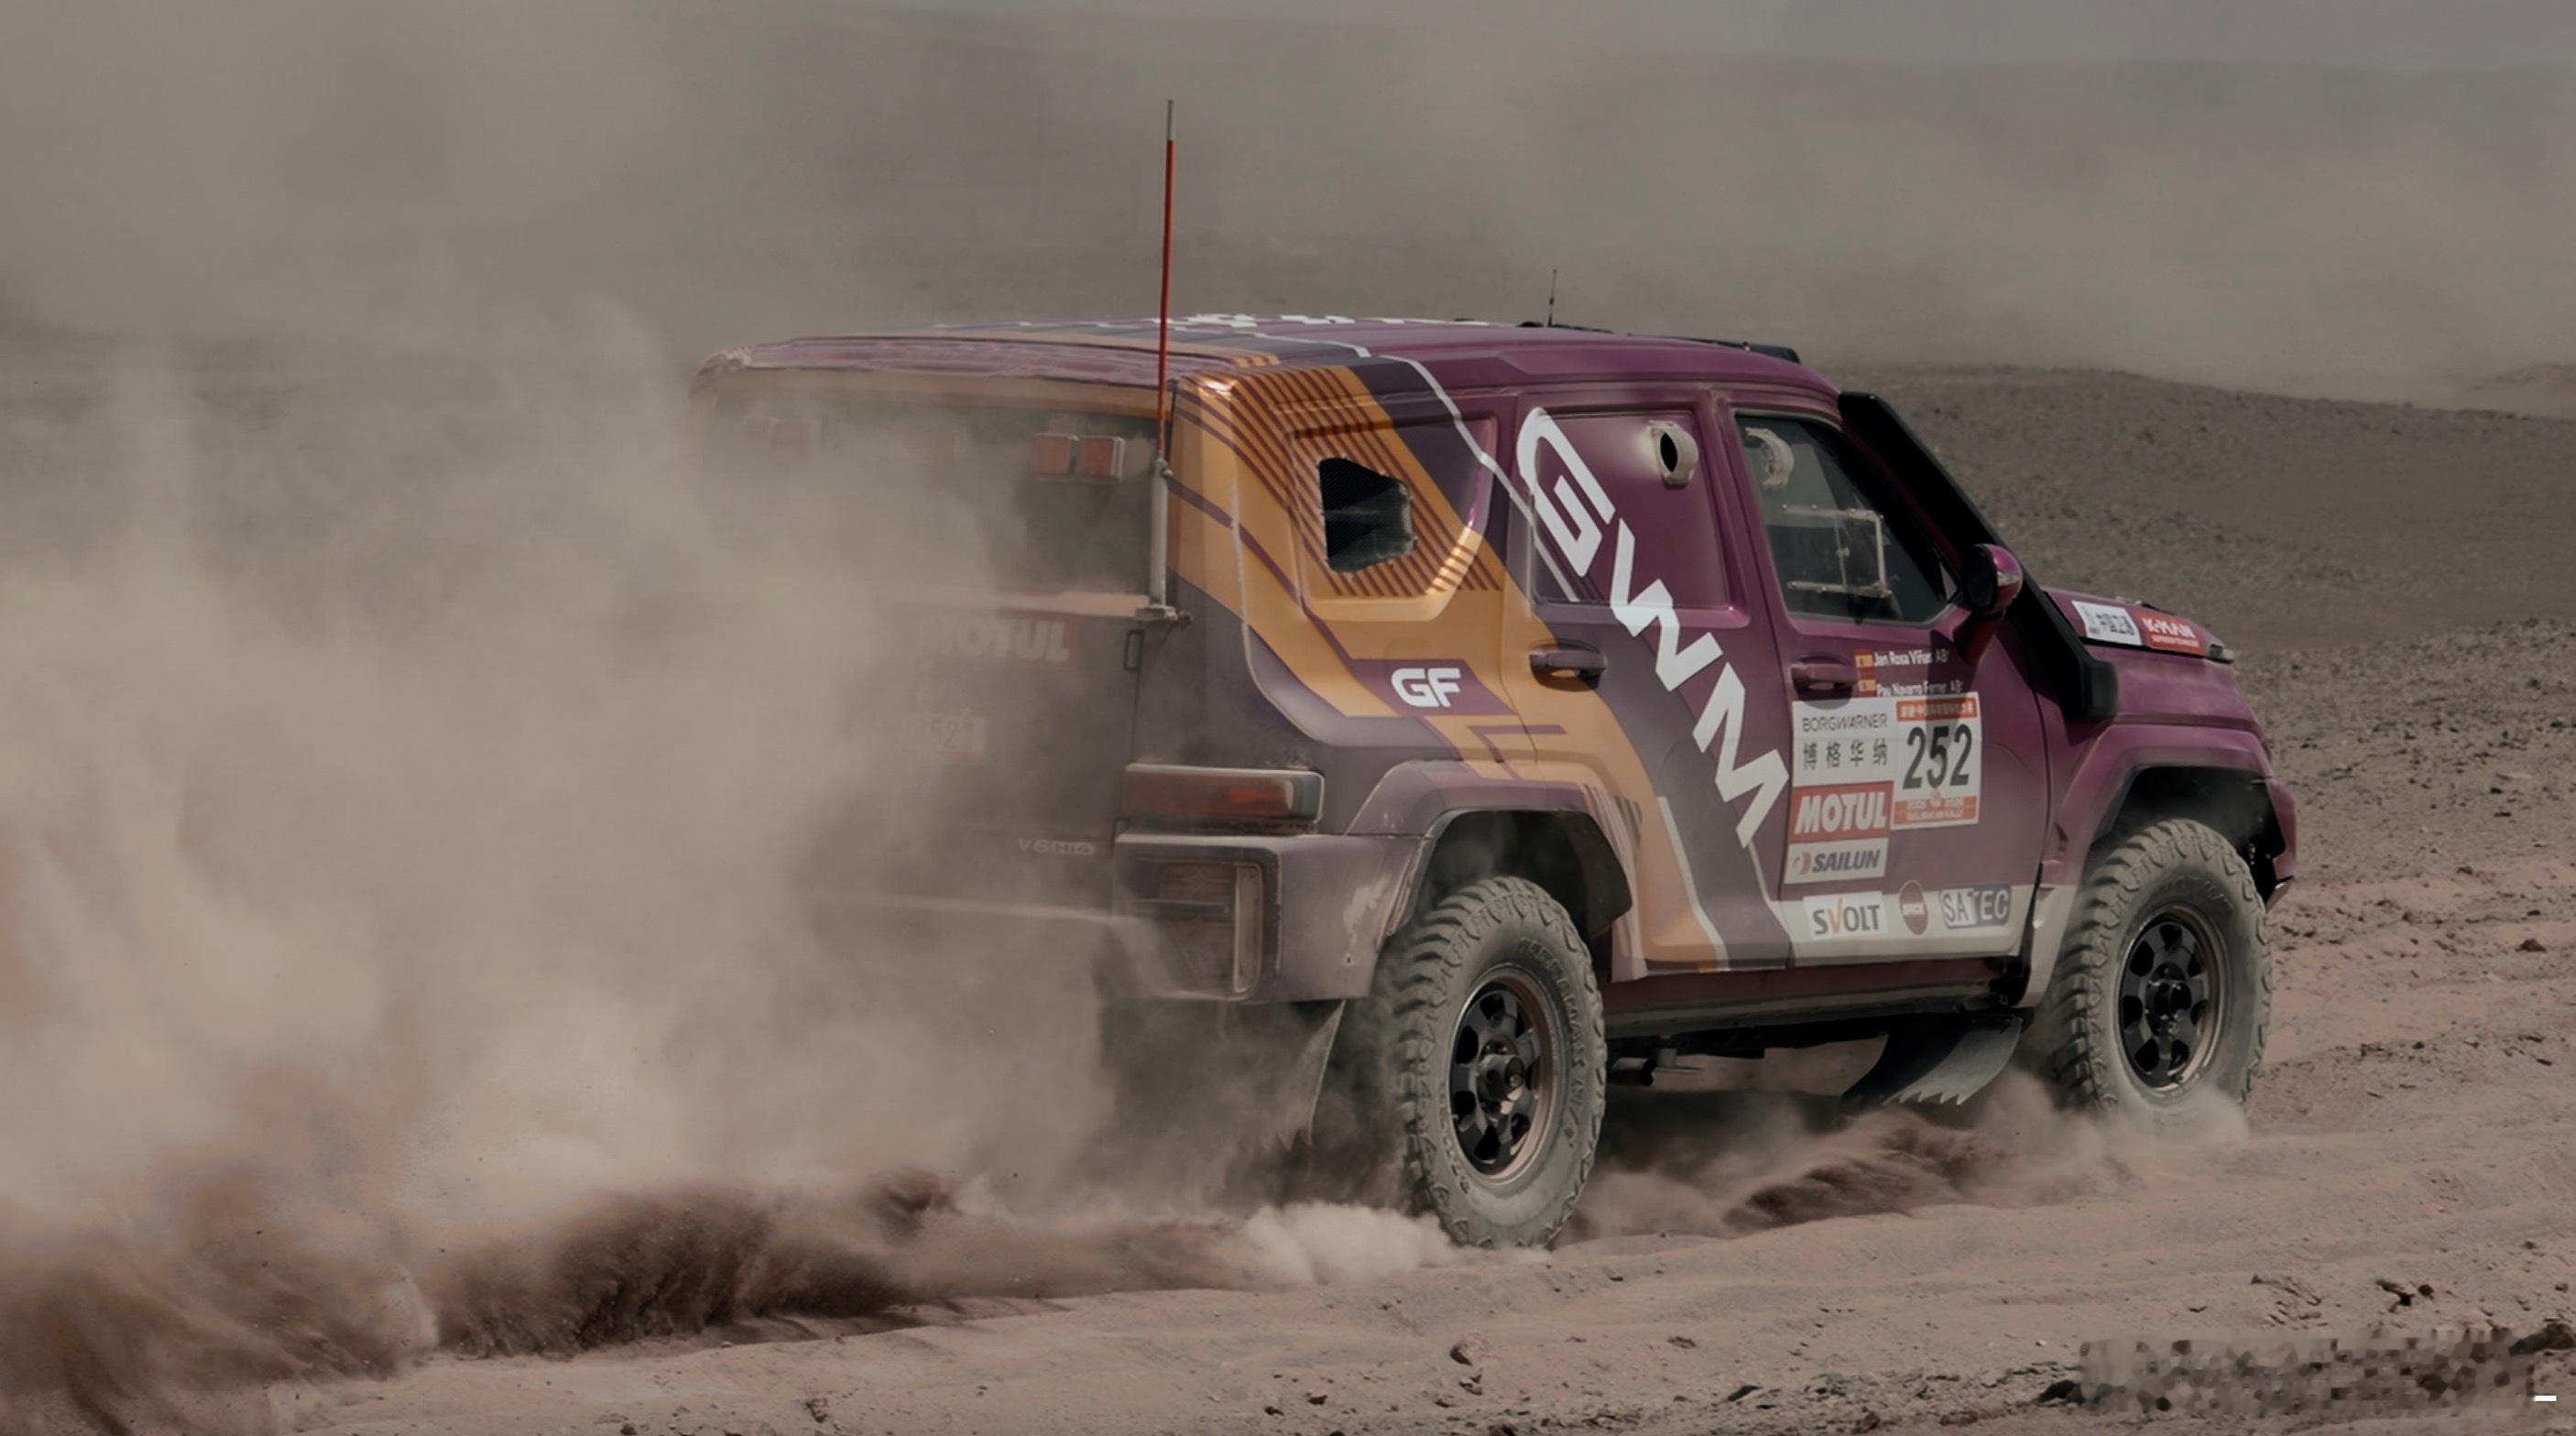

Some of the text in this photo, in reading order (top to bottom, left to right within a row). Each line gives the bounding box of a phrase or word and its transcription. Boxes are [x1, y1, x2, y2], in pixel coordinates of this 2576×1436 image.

[920, 616, 1071, 662] OTUL
[1516, 407, 1790, 849] GWM
[1391, 667, 1462, 708] GF
[1802, 713, 1888, 733] BORGWARNER
[1902, 723, 1973, 790] 252
[1794, 791, 1888, 835] MOTUL
[1812, 849, 1881, 873] SAILUN
[1812, 896, 1881, 935] SVOLT
[1941, 888, 2010, 923] SATEC
